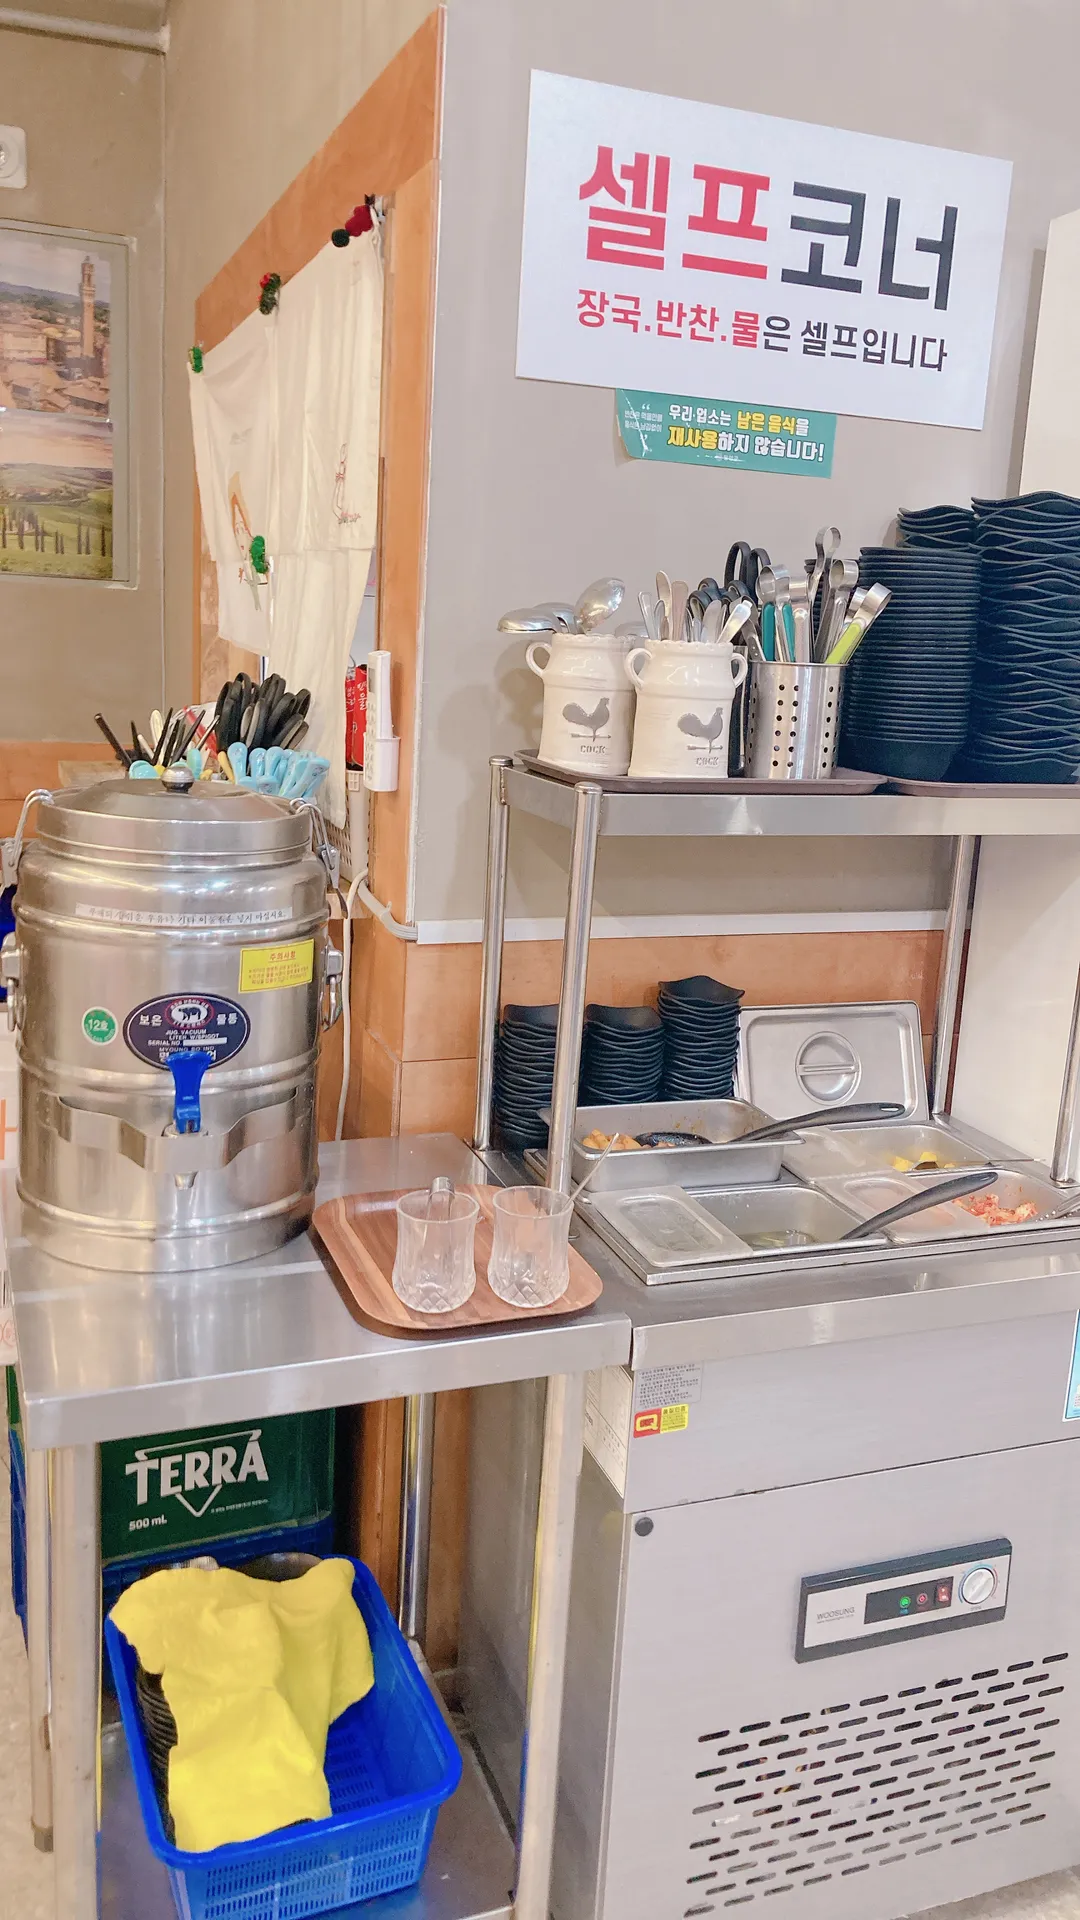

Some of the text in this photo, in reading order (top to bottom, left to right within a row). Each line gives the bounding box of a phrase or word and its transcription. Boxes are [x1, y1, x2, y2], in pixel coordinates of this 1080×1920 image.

[579, 145, 958, 311] 셀프코너
[577, 289, 948, 372] 장국.반찬.물은 셀프입니다
[737, 410, 765, 432] 남은
[768, 415, 809, 437] 음식을
[667, 425, 824, 463] 재사용하지 않습니다!
[580, 744, 606, 754] COCK
[695, 756, 719, 766] COCK
[139, 1014, 162, 1027] 보온
[181, 1028, 207, 1036] VACUUM
[125, 1429, 269, 1506] TERRA
[129, 1517, 150, 1531] 500
